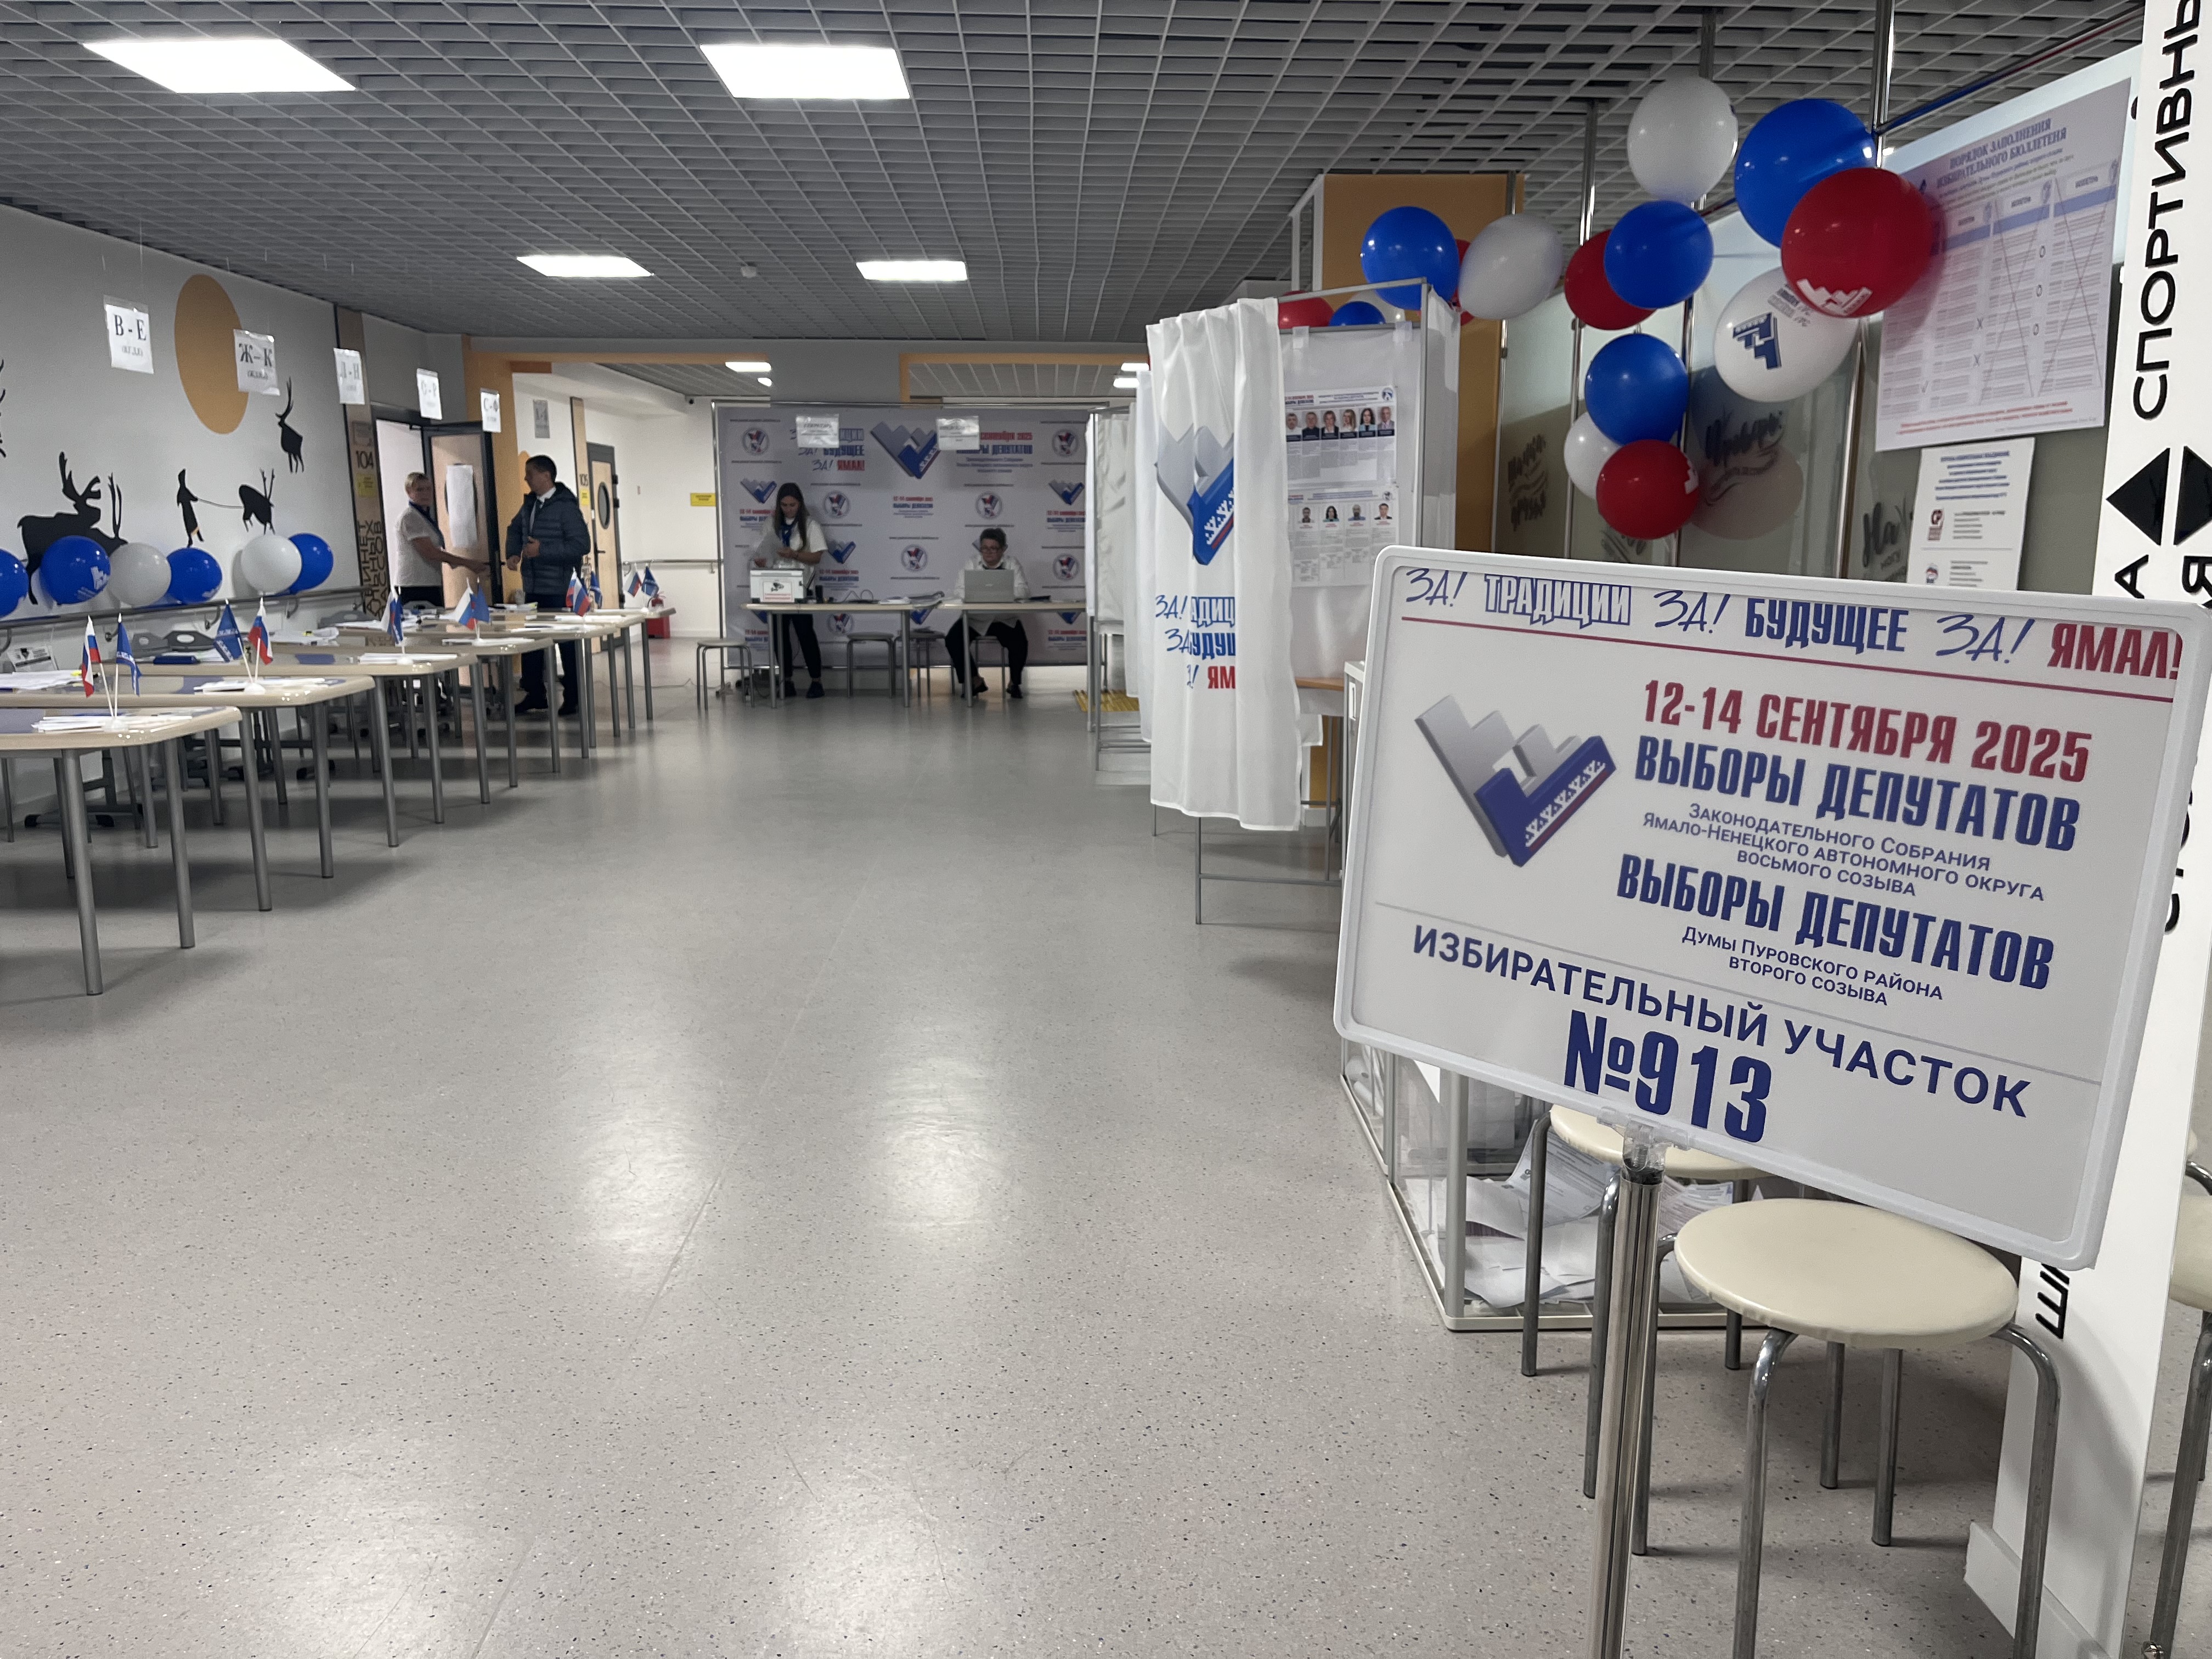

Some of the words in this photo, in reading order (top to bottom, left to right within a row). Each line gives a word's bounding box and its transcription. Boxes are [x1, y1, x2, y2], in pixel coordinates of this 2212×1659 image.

[356, 450, 374, 469] 104
[1155, 594, 1188, 620] ЗА!
[1405, 568, 1468, 608] ЗА!
[1484, 573, 1632, 629] ТРАДИЦИИ
[1654, 589, 1731, 634] ЗА!
[1745, 597, 1909, 654] БУДУЩЕЕ
[1937, 613, 2036, 664] ЗА!
[2047, 623, 2183, 680] ЯМАЛ!
[1644, 679, 1743, 734] 12-14
[1756, 693, 1958, 764] СЕНТЯБРЯ
[1971, 721, 2093, 784] 2025
[1635, 735, 1806, 806] ВЫБОРЫ
[1816, 763, 2081, 852] ДЕПУТАТОВ
[1616, 853, 1785, 932] ВЫБОРЫ
[1795, 890, 2055, 991] ДЕПУТАТОВ
[1412, 924, 1769, 1047] ИЗБИРАТЕЛЬНЫЙ
[1783, 1019, 2032, 1119] УЧАСТОК
[1564, 1009, 1772, 1143] №913
